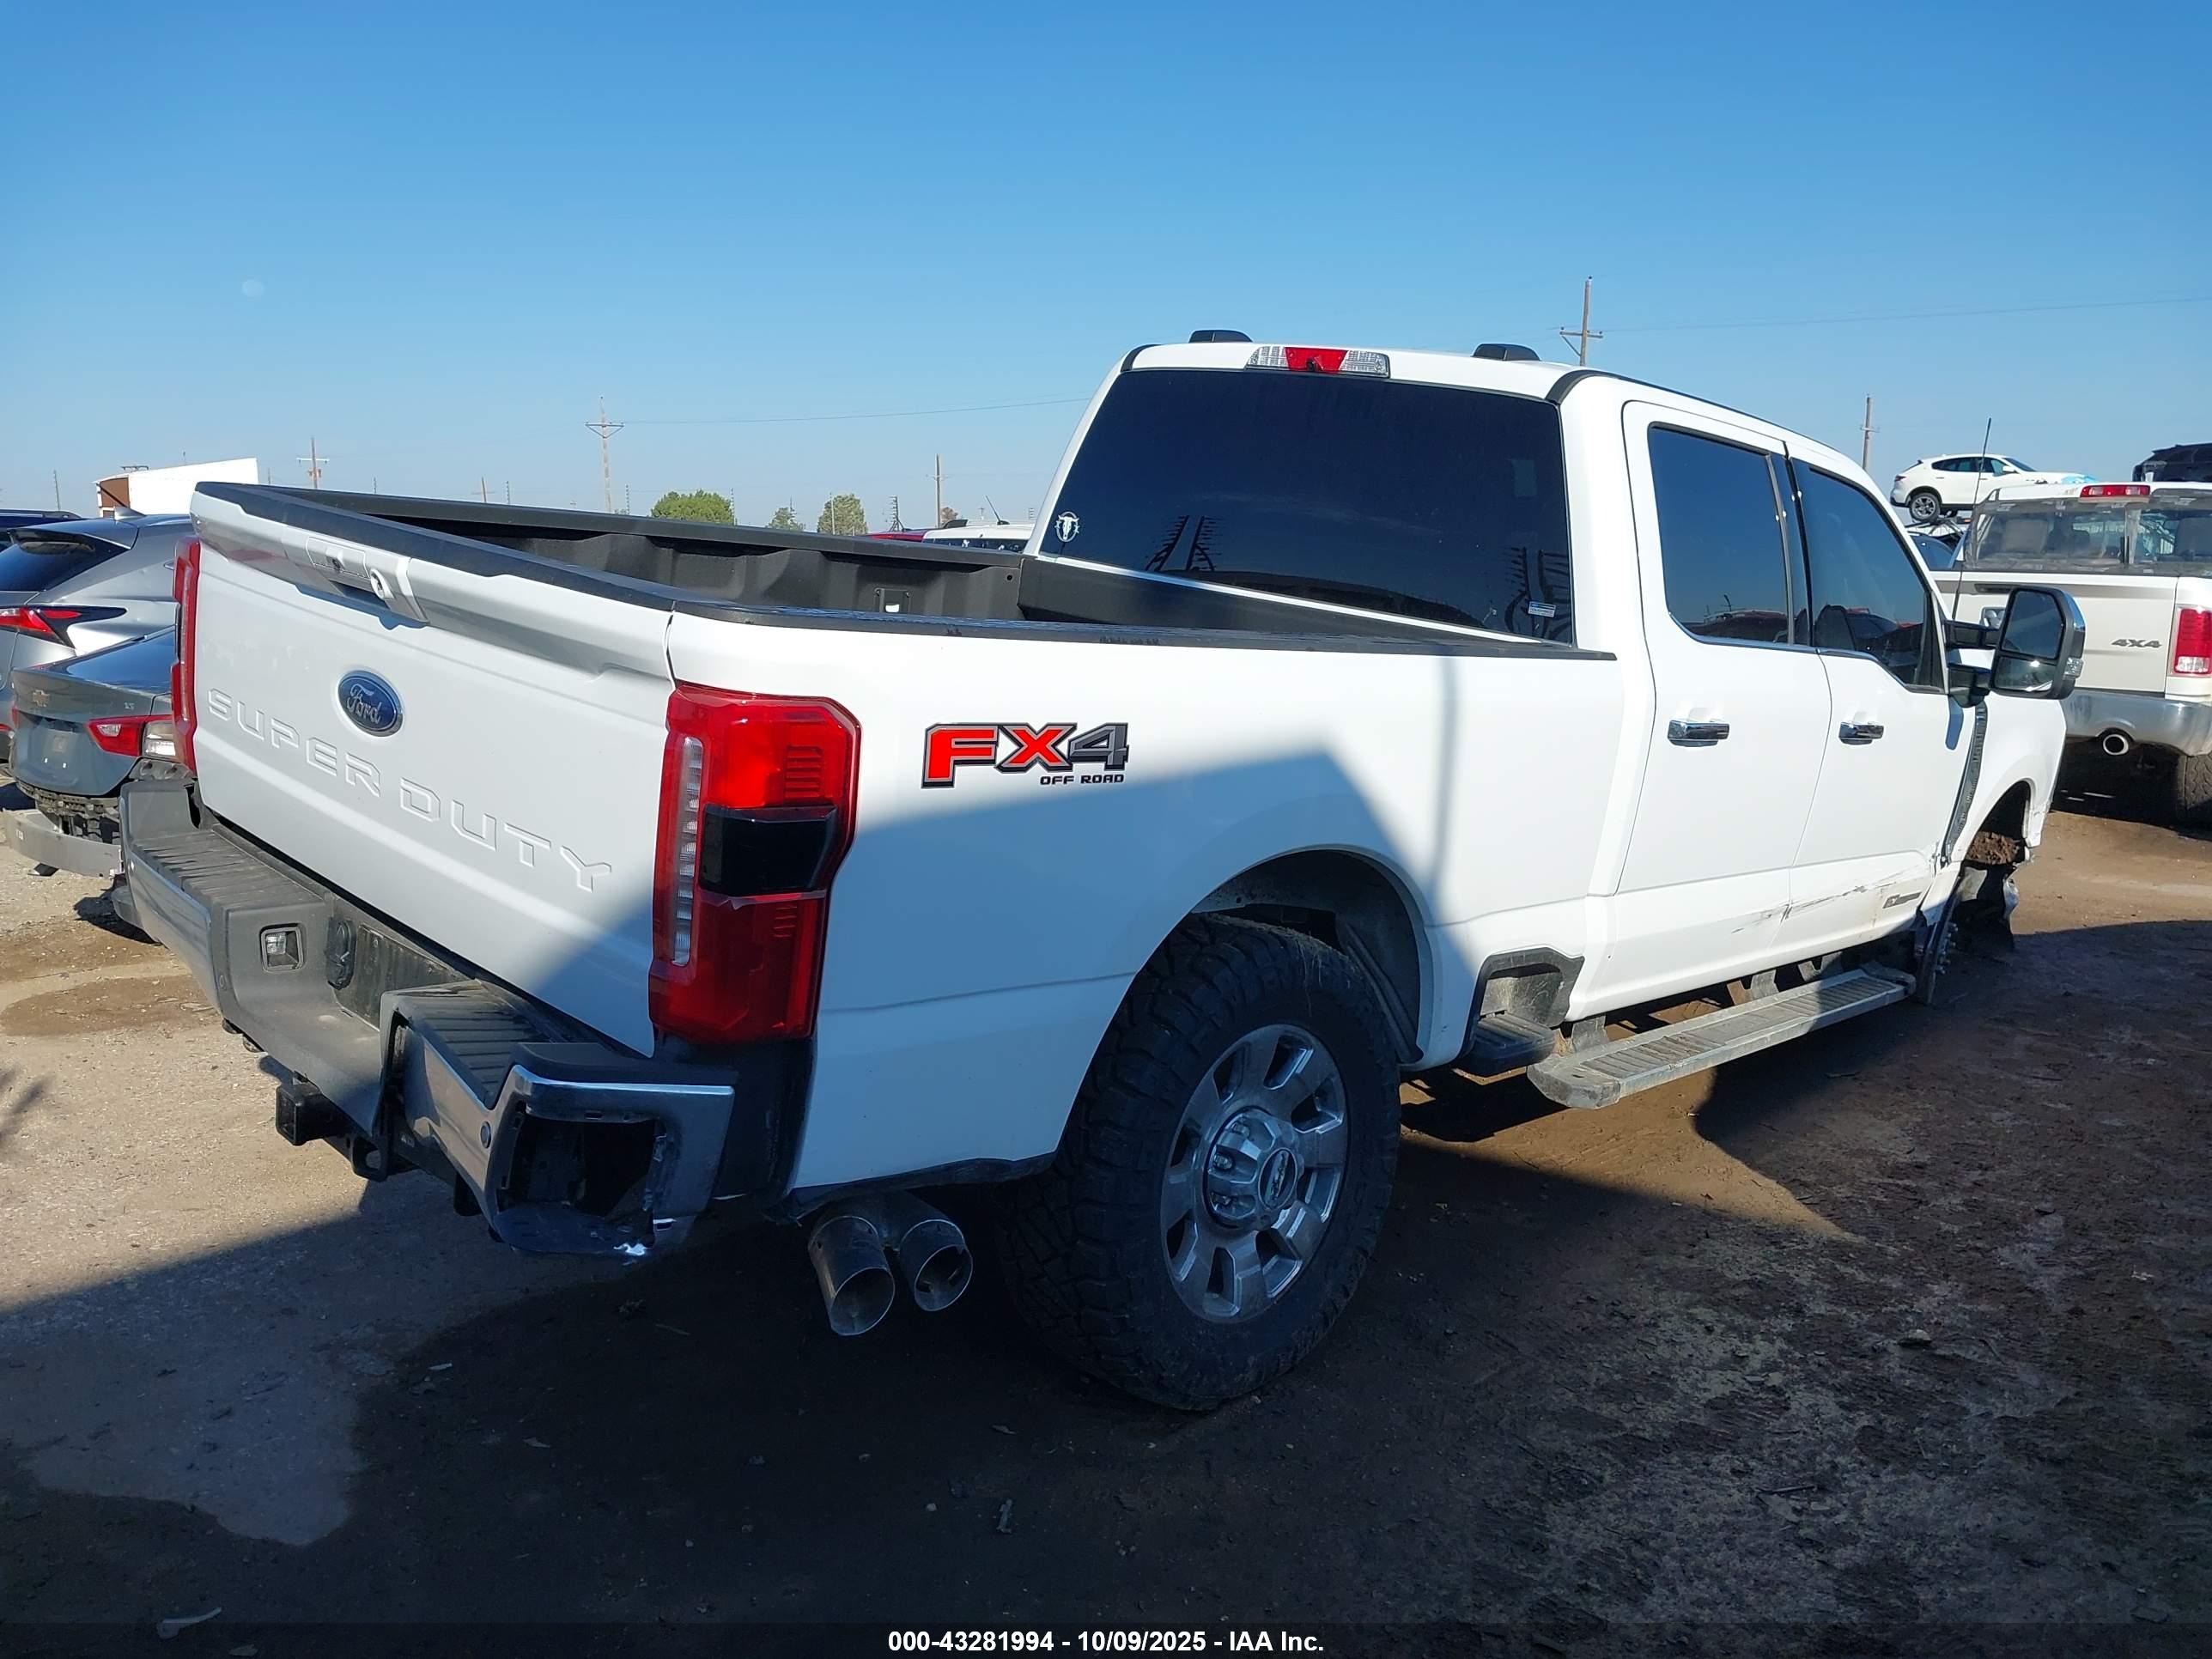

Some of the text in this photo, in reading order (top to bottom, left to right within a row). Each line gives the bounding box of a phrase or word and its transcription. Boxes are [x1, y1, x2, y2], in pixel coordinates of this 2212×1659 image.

[921, 722, 1128, 789] FX4
[1039, 774, 1125, 786] OFF ROAD
[207, 688, 612, 893] SUPER DUTY
